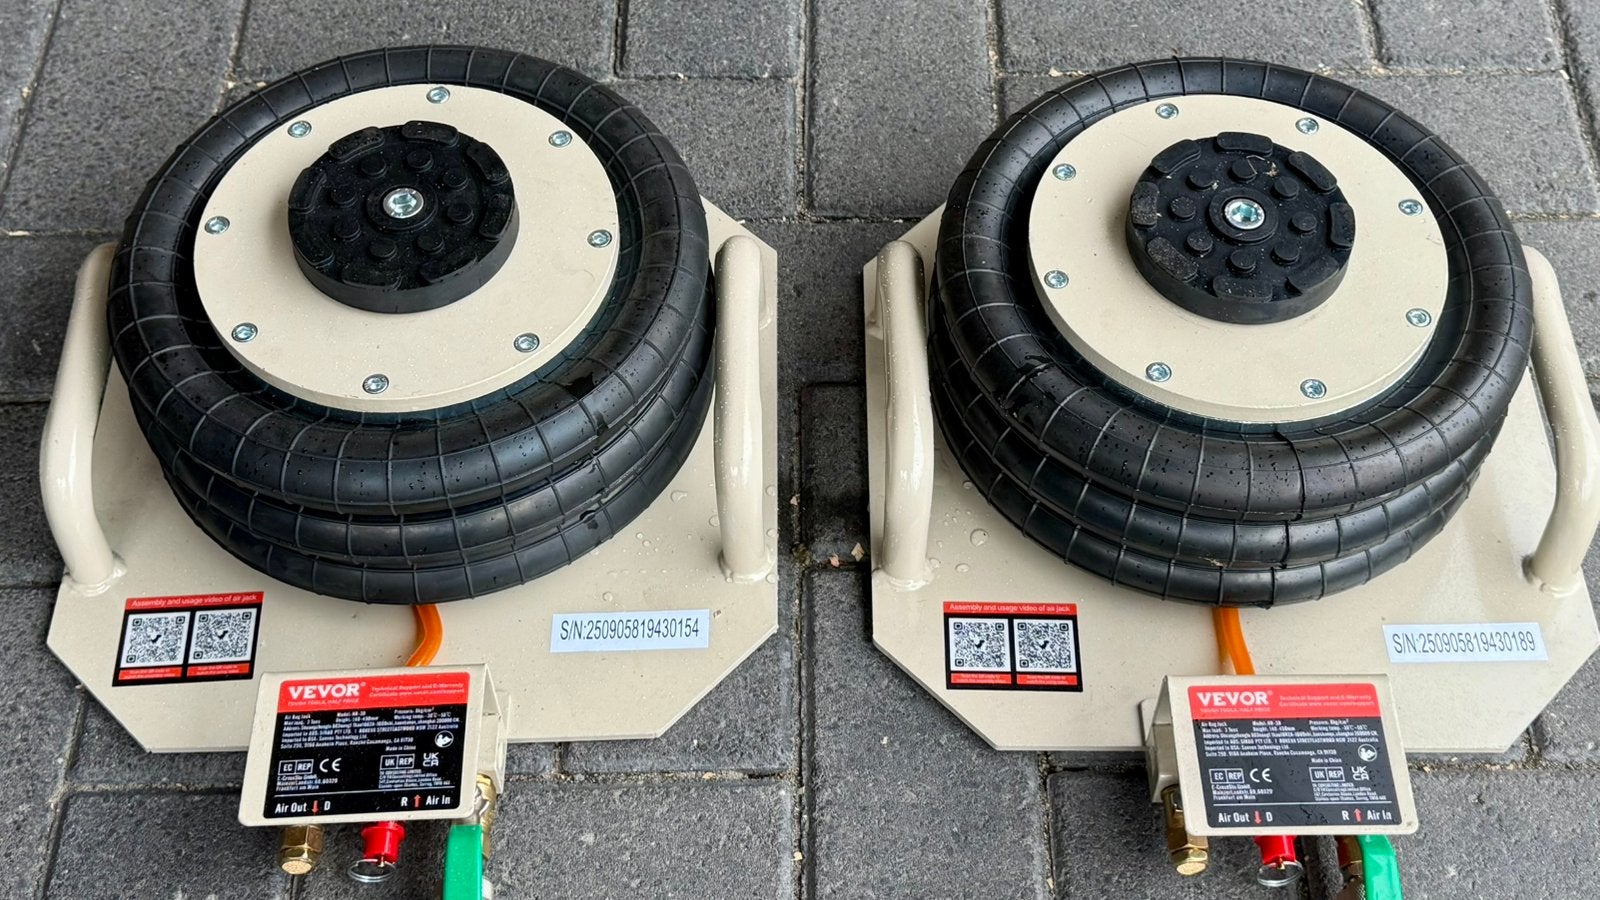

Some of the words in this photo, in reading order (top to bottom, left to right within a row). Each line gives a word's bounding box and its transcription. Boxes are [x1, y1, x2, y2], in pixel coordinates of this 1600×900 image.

[182, 598, 202, 606] usage
[241, 594, 256, 602] jack
[950, 603, 982, 612] Assembly
[560, 618, 699, 640] S/N:250905819430154
[1392, 631, 1536, 654] S/N:250905819430189
[283, 764, 293, 772] EC
[297, 762, 312, 771] REP
[384, 758, 396, 766] UK
[399, 758, 414, 766] REP
[1214, 772, 1224, 780] EC
[1228, 772, 1242, 780] REP
[1314, 770, 1326, 779] UK
[1328, 770, 1342, 778] REP
[400, 796, 408, 806] R
[425, 796, 440, 806] Air
[442, 794, 451, 804] In
[274, 804, 289, 814] Air
[290, 802, 308, 812] Out
[324, 800, 331, 810] D
[1218, 812, 1232, 822] Air
[1233, 812, 1250, 822] Out
[1266, 812, 1274, 822] D
[1341, 810, 1350, 820] R
[1367, 810, 1380, 820] Air
